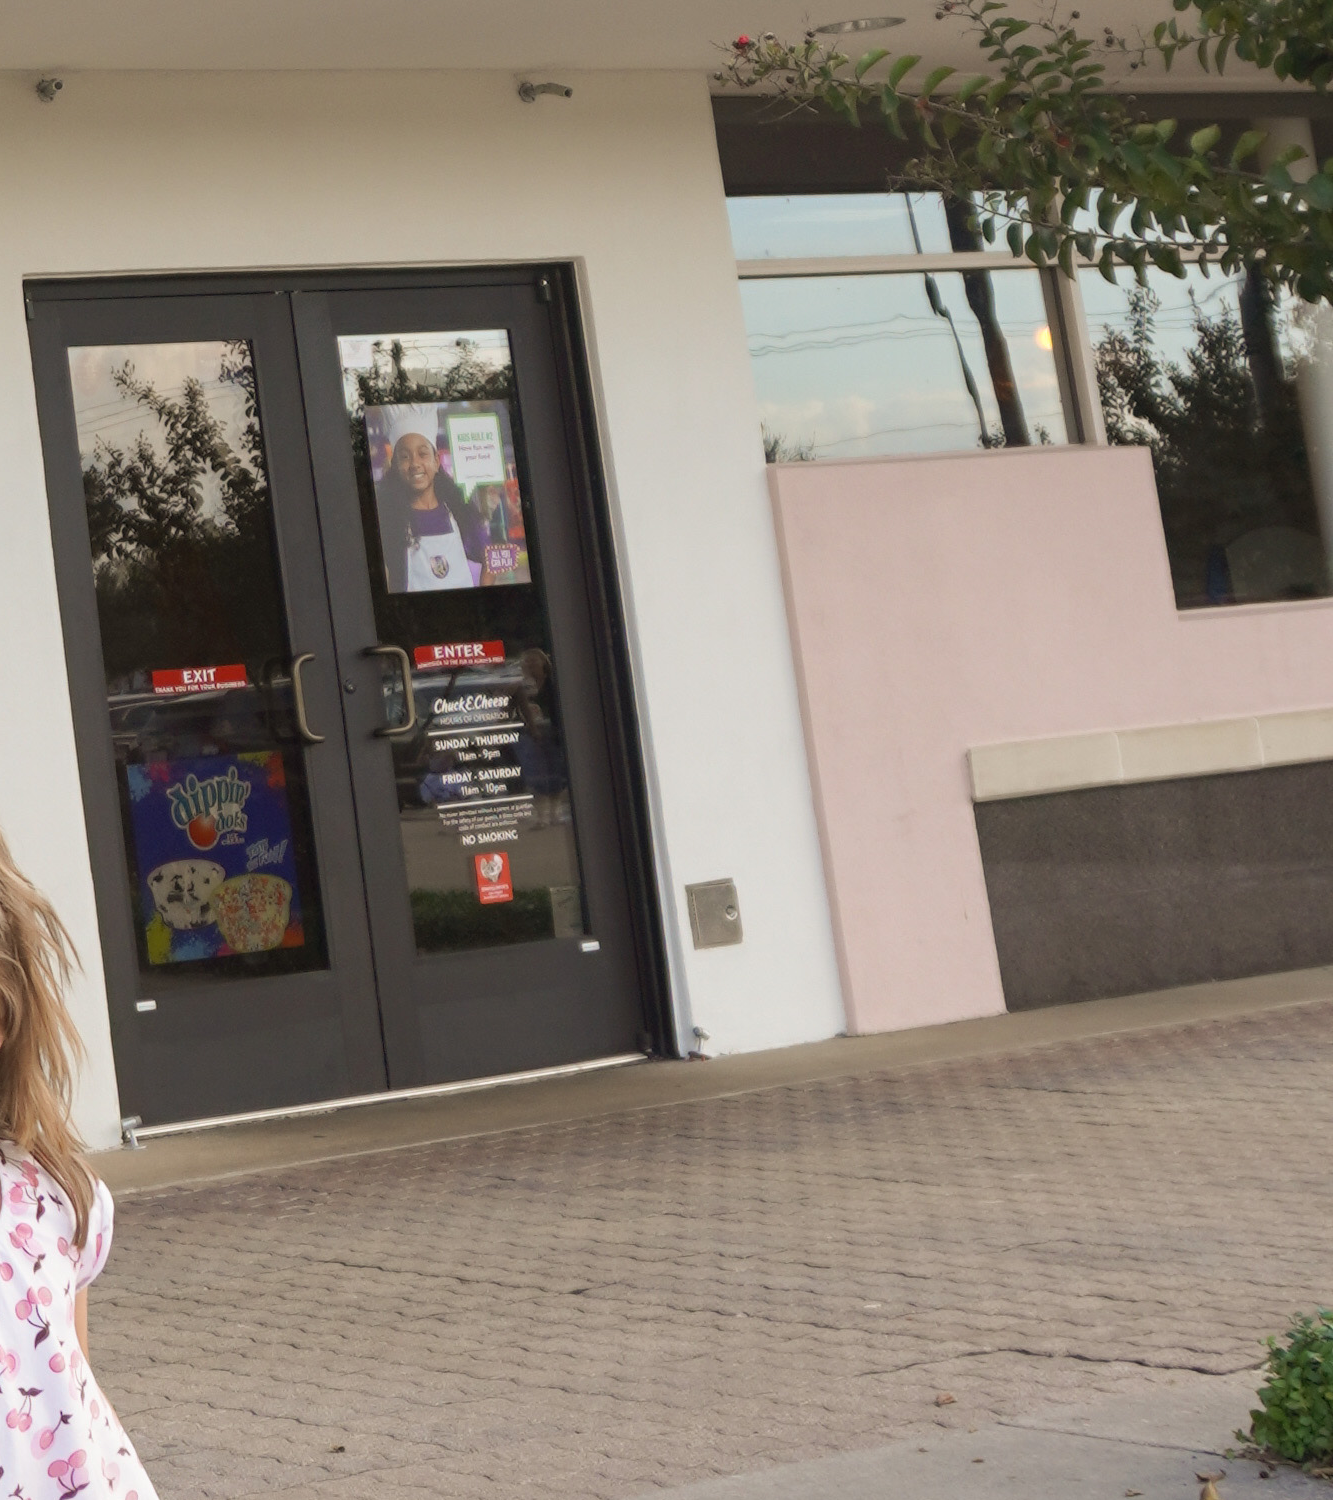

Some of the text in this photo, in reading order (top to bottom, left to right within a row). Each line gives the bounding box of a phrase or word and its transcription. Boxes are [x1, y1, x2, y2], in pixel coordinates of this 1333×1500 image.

[434, 643, 486, 660] ENTER
[183, 668, 217, 684] EXIT
[175, 685, 187, 693] YOU
[440, 711, 509, 725] HOURS OF OPERATION
[435, 738, 470, 751] SUNDAY
[475, 732, 520, 747] THURSDAY
[458, 751, 477, 761] 11am
[482, 749, 501, 760] 9pm
[442, 772, 473, 785] FRIDAY
[478, 766, 522, 780] SATURDAY
[461, 785, 479, 796] 11am
[485, 782, 507, 794] 10pm
[215, 811, 245, 832] dots
[462, 829, 519, 846] NO SMOKING
